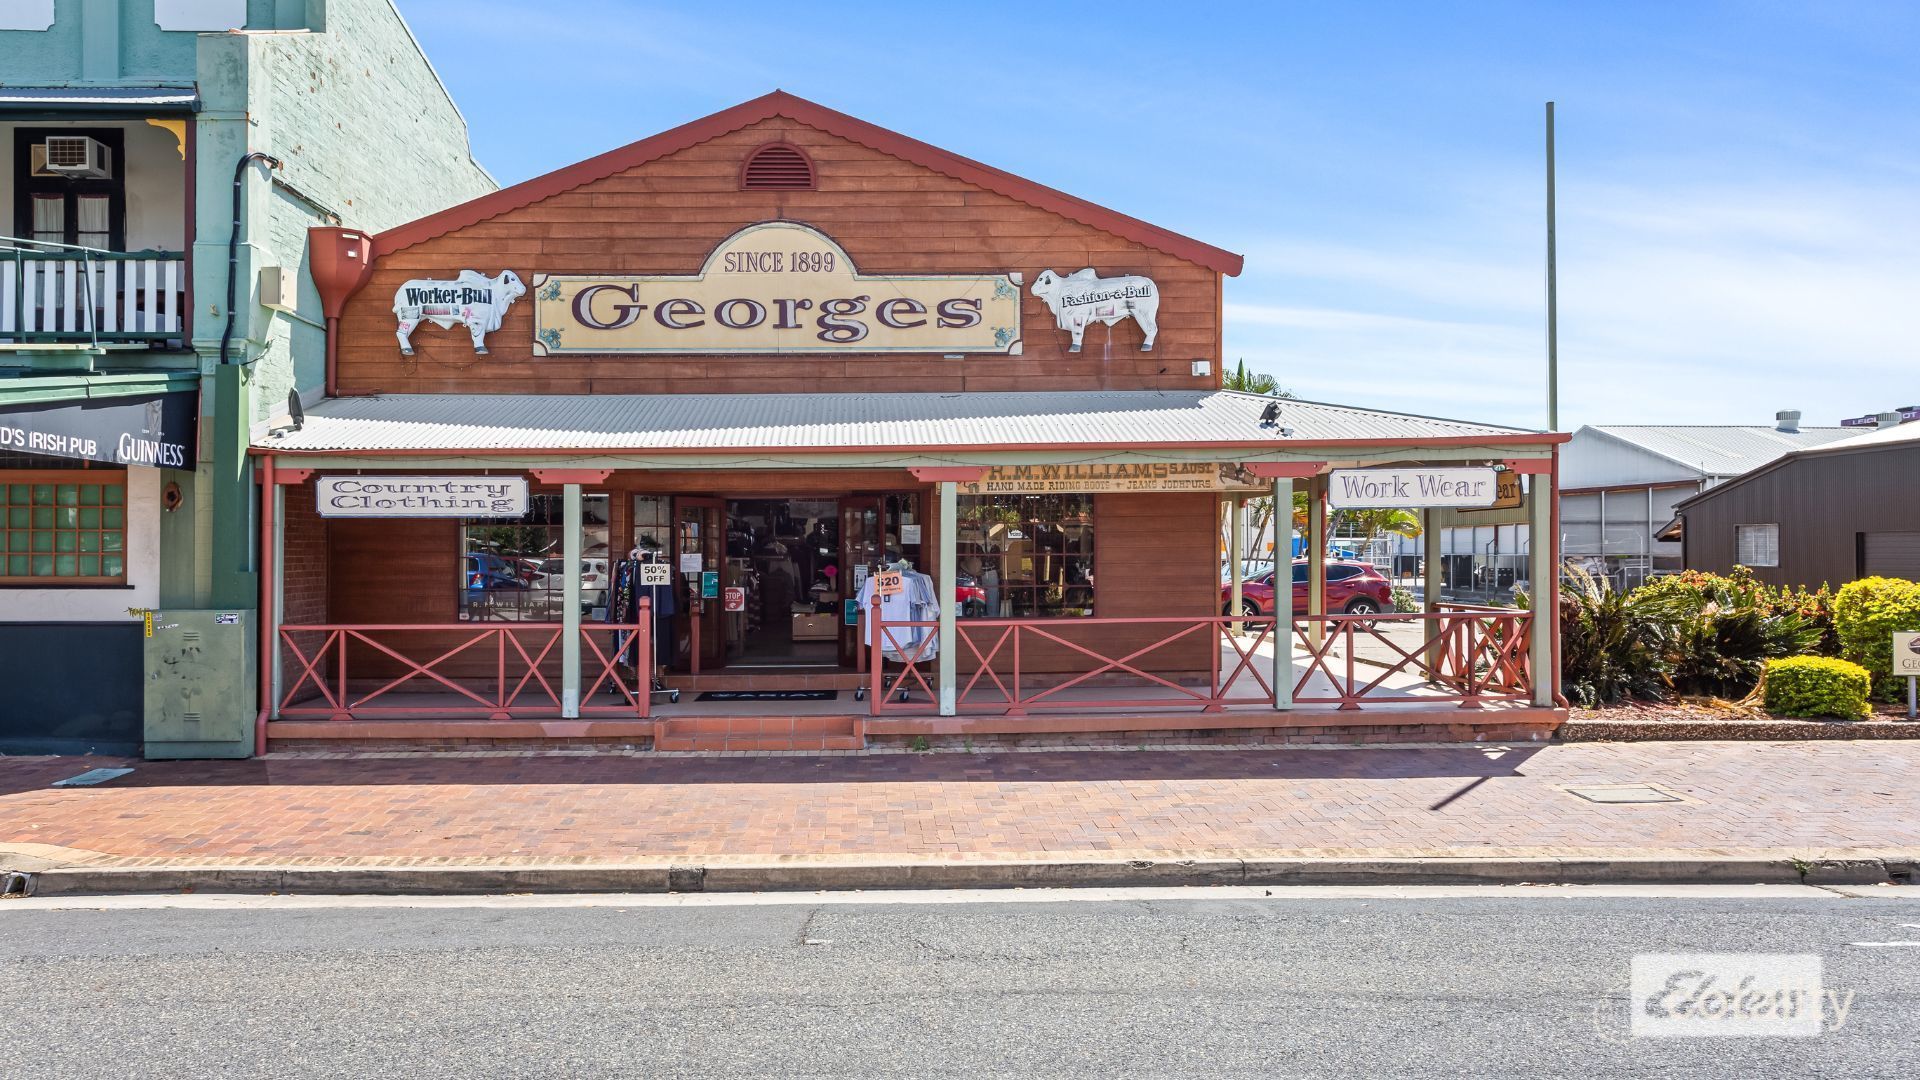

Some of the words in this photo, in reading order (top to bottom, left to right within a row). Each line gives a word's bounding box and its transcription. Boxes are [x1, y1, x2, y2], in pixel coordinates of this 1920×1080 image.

[724, 251, 783, 273] SINCE
[790, 251, 835, 273] 1899
[405, 287, 492, 306] Worker-Bull
[571, 283, 982, 343] Georges
[0, 427, 25, 447] D'S
[29, 431, 67, 452] IRISH
[70, 437, 97, 456] PUB
[119, 432, 184, 467] GUINNESS
[332, 480, 511, 498] Country
[987, 481, 1014, 491] HAND
[1017, 481, 1045, 491] MADE
[1049, 481, 1081, 490] RIDING
[1084, 480, 1110, 490] BOOTS
[1126, 480, 1157, 489] JEANS
[1341, 475, 1410, 499] Work
[1417, 474, 1486, 497] Wear
[330, 495, 515, 513] Clothing
[644, 565, 667, 574] 50%
[646, 575, 665, 583] OFF
[724, 591, 741, 600] STOP
